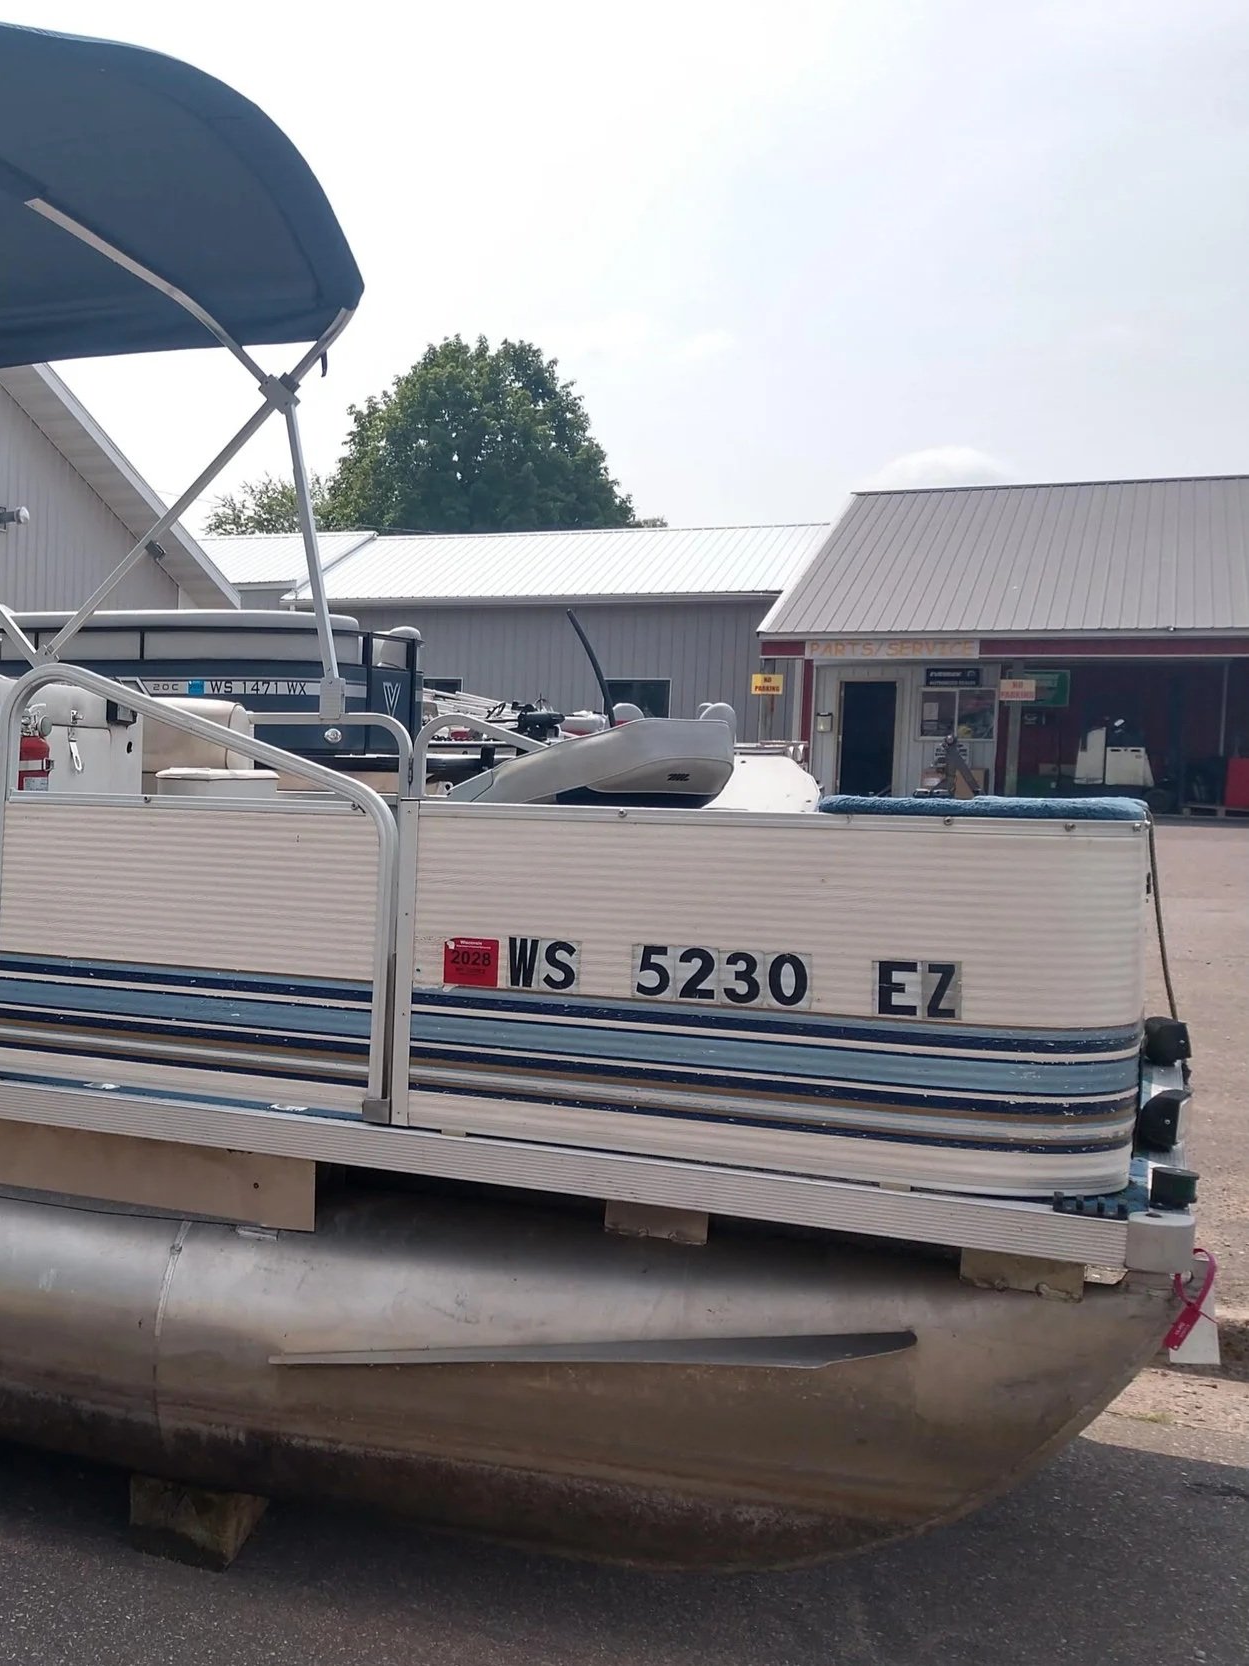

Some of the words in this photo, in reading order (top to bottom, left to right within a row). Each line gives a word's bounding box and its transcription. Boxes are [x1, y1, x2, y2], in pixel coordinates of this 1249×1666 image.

[809, 641, 975, 657] PARTS/SERVICE
[153, 683, 179, 691] 20C
[210, 681, 233, 694] WS
[243, 681, 278, 695] 1471
[287, 682, 307, 695] WX
[1012, 681, 1023, 689] NO
[1000, 691, 1033, 699] PARKING
[450, 950, 491, 967] 2028
[508, 936, 577, 990] WS
[636, 945, 808, 1007] 5230
[877, 960, 956, 1018] EZ
